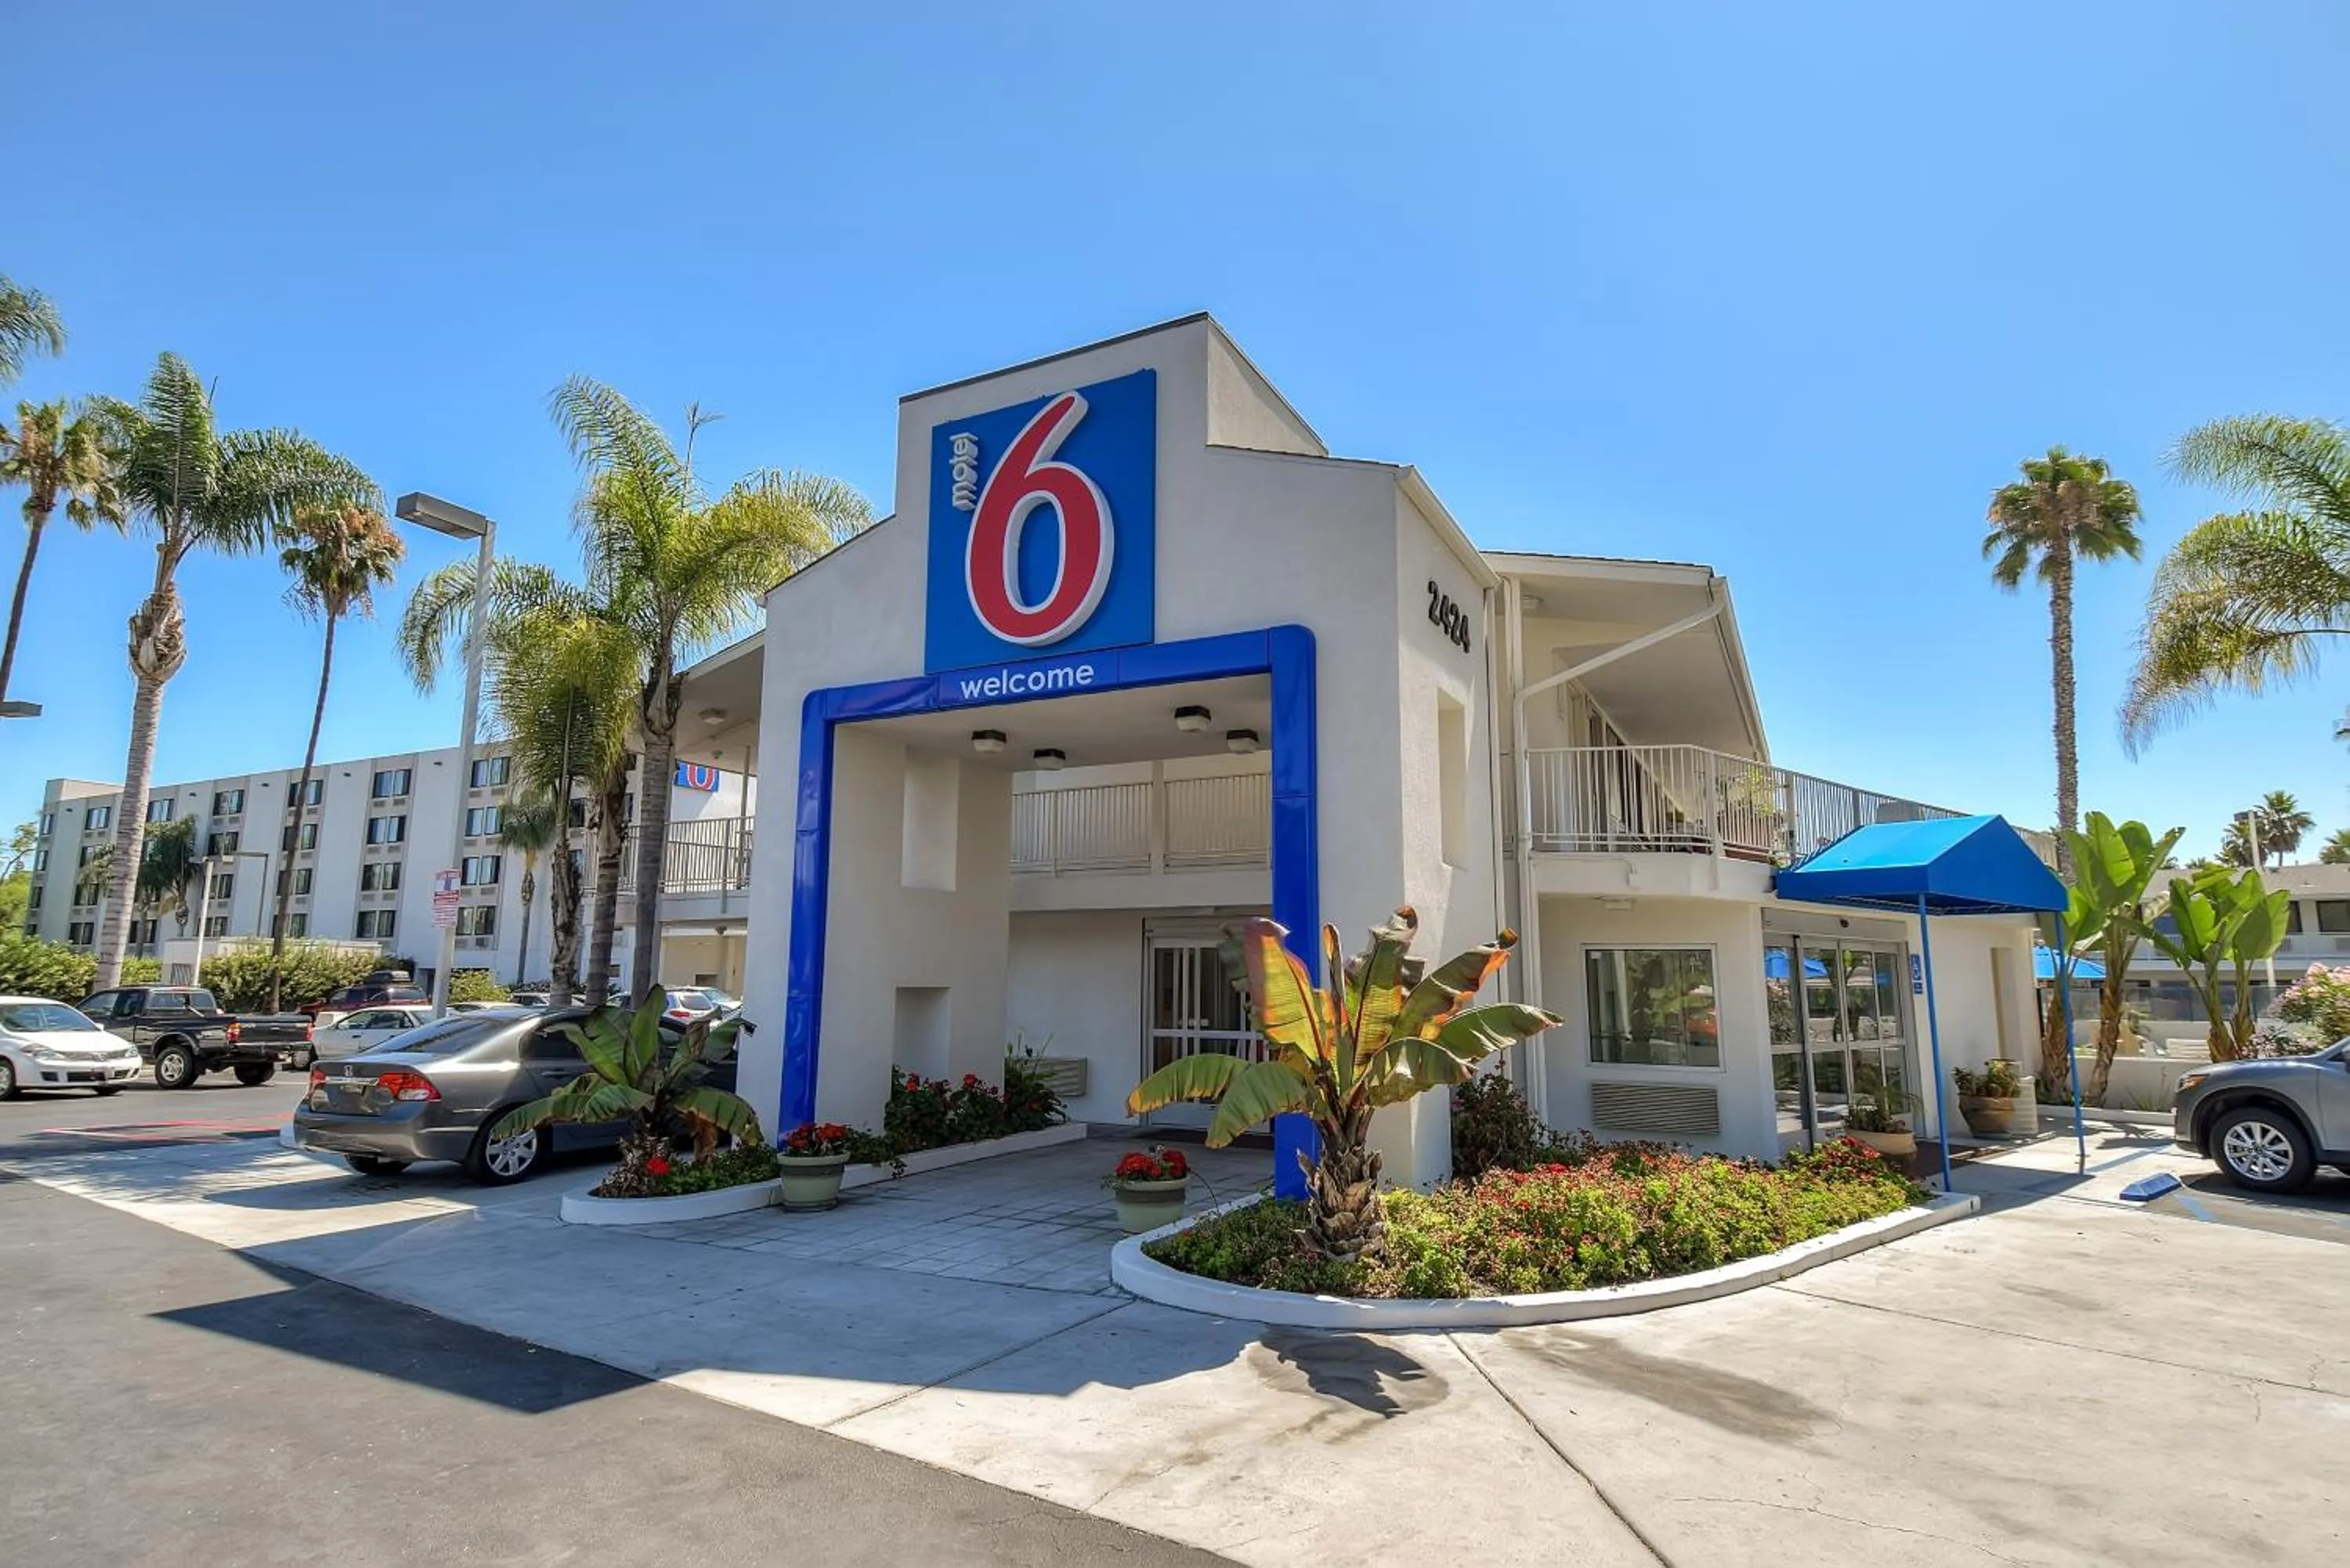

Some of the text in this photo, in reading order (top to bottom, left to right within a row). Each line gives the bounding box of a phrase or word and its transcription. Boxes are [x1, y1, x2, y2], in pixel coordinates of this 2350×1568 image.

[949, 432, 978, 511] motel
[966, 391, 1114, 647] 6
[1427, 580, 1470, 653] 2424
[960, 665, 1094, 699] welcome
